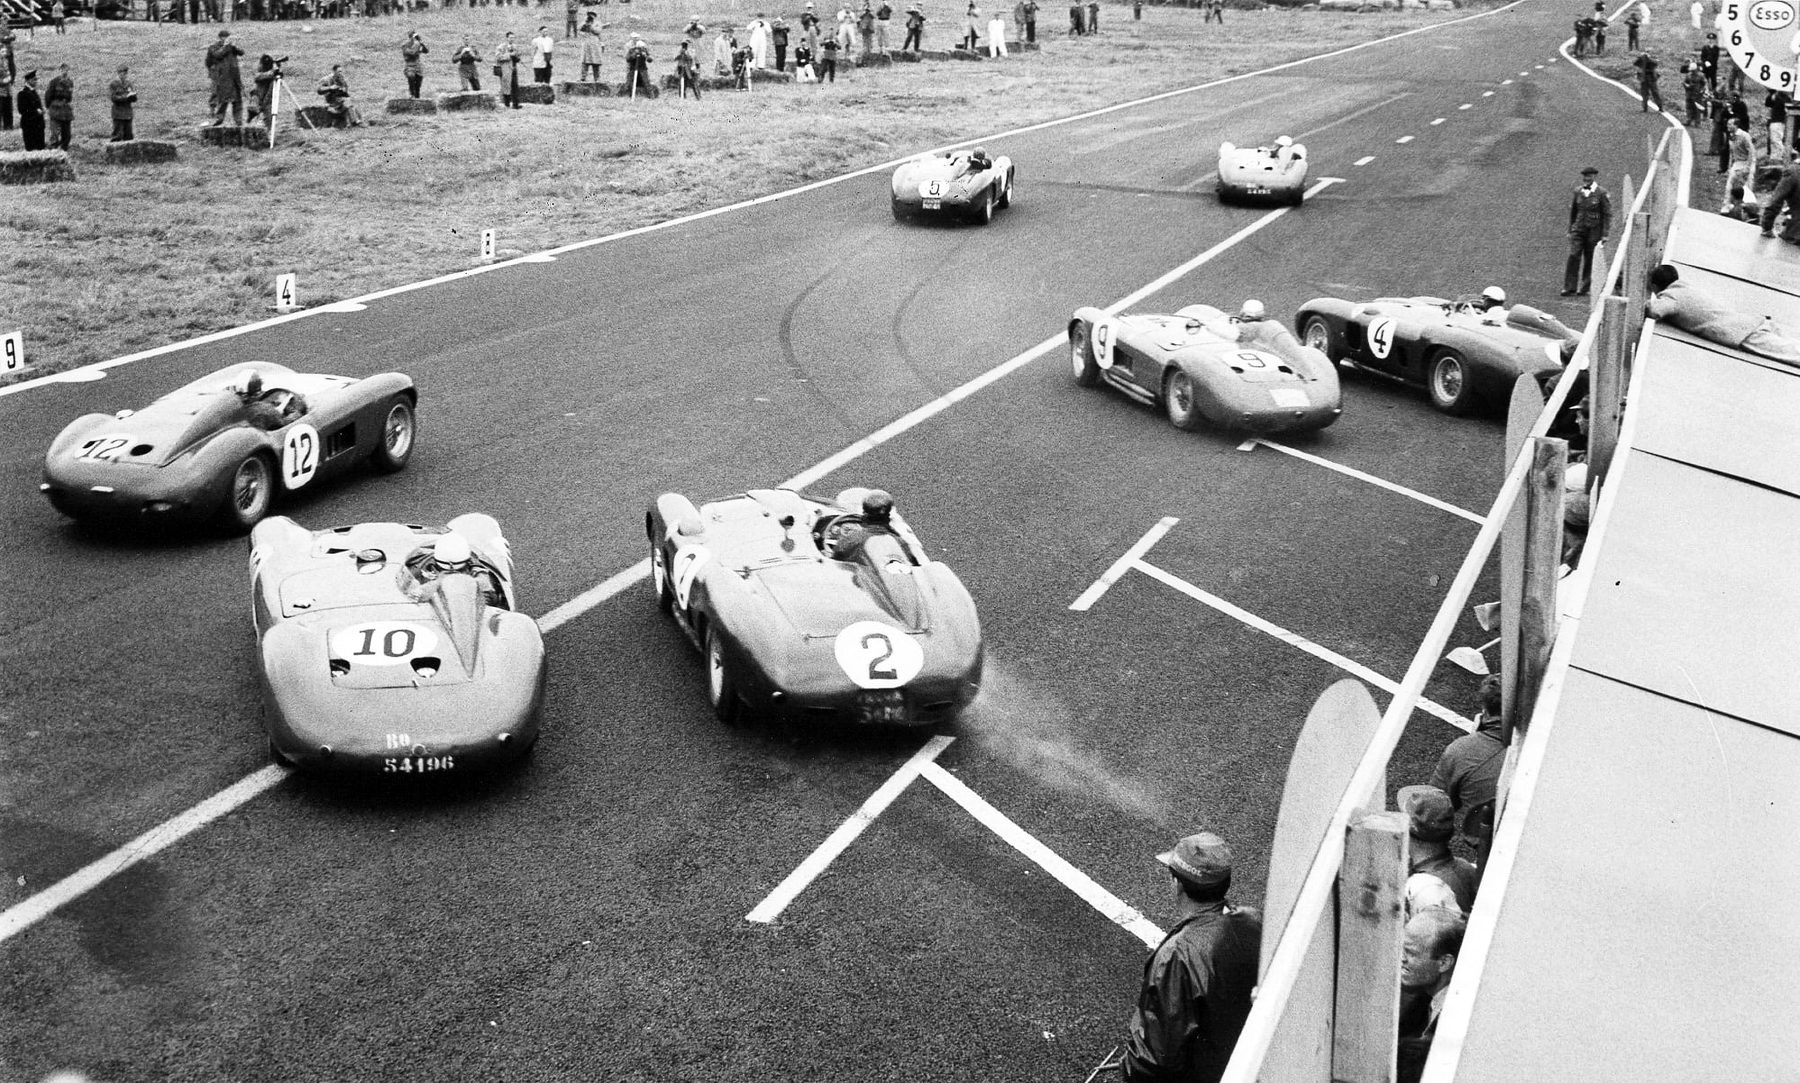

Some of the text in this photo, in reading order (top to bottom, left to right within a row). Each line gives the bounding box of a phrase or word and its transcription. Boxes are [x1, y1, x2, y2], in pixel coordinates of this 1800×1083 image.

[1728, 4, 1738, 21] 5
[1731, 30, 1742, 46] 6
[1745, 52, 1755, 68] 7
[1760, 64, 1771, 81] 8
[1780, 71, 1791, 87] 9
[929, 180, 940, 195] 5
[282, 279, 291, 305] 4
[1098, 324, 1108, 360] 9
[1374, 320, 1390, 354] 4
[5, 338, 16, 369] 9
[1237, 352, 1266, 369] 9
[82, 438, 129, 461] 12
[290, 433, 312, 478] 12
[353, 628, 416, 658] 10
[861, 633, 898, 680] 2
[384, 755, 455, 773] 54196
